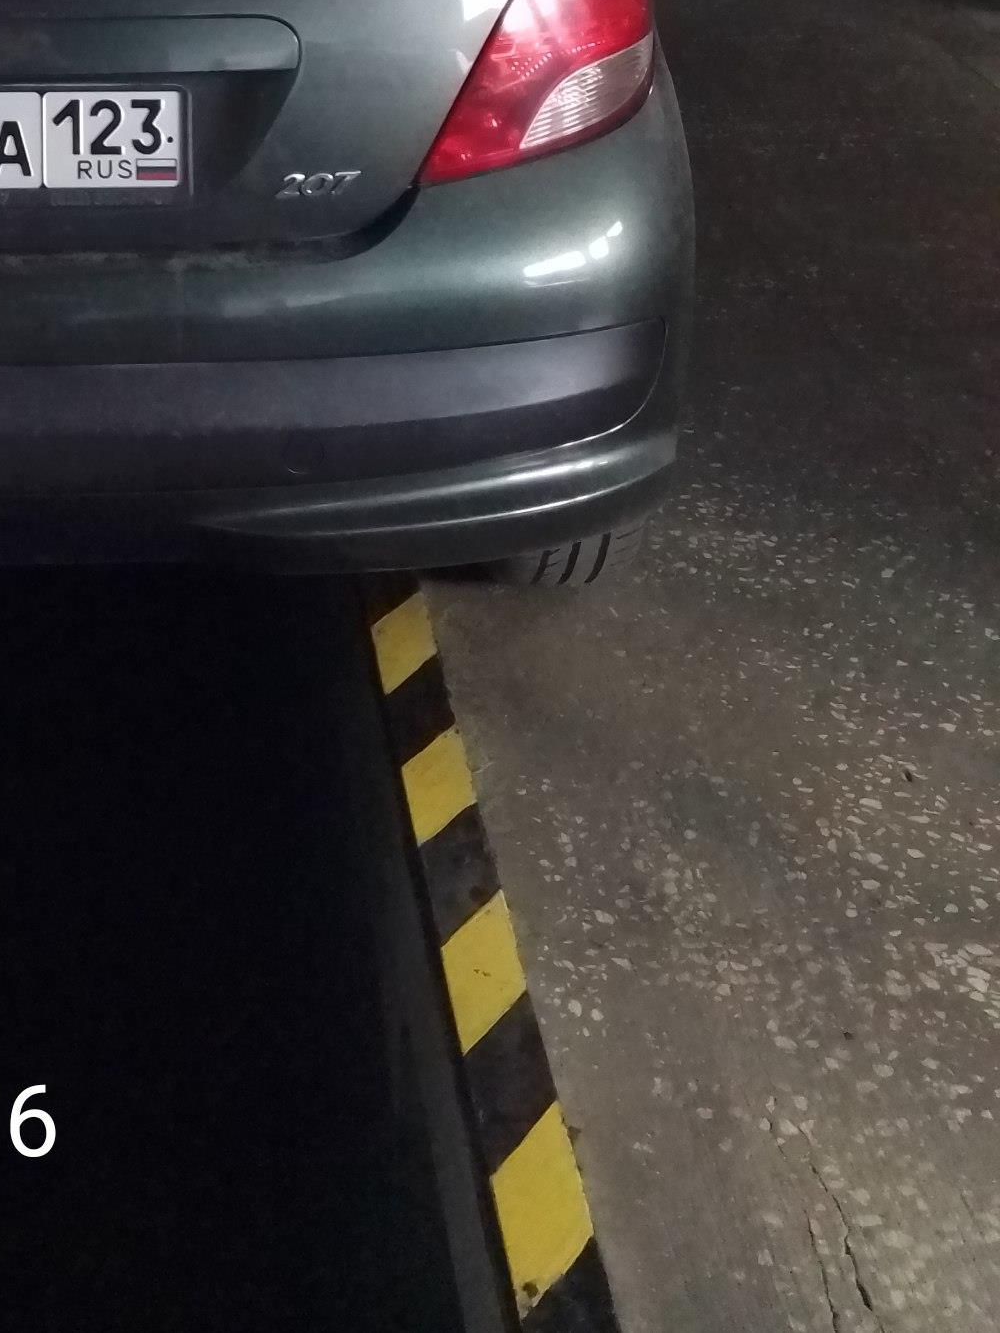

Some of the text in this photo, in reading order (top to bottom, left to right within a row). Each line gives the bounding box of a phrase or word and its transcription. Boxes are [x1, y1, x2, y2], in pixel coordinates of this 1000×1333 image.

[52, 99, 162, 156] 123
[77, 159, 133, 180] RUS
[275, 170, 361, 198] 207
